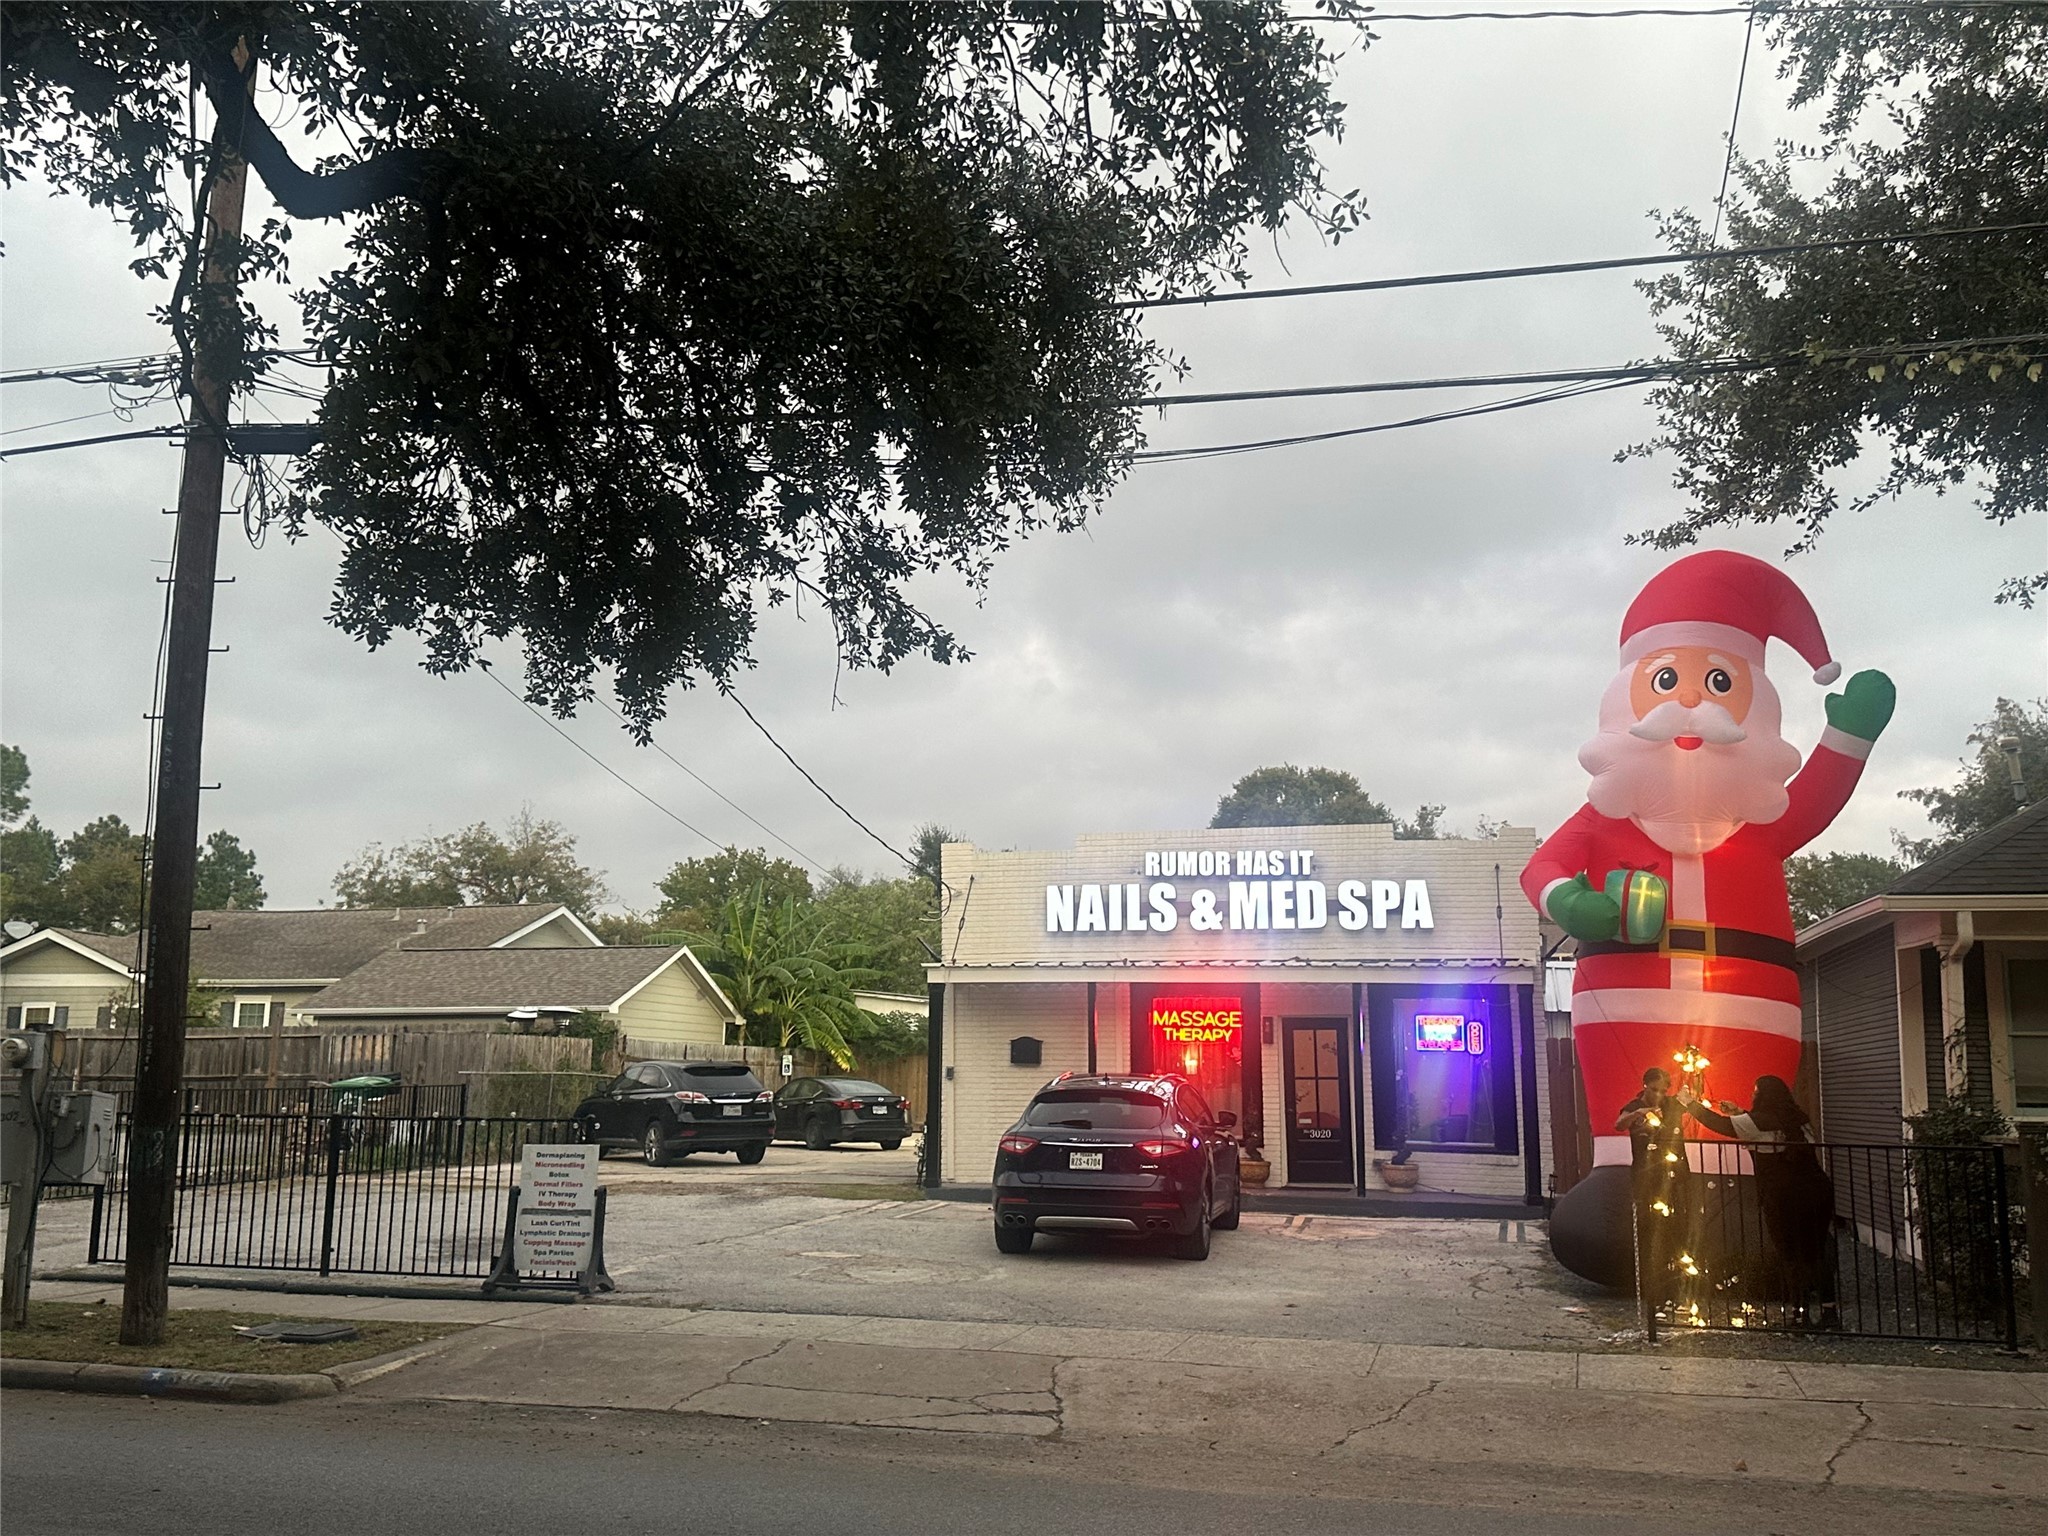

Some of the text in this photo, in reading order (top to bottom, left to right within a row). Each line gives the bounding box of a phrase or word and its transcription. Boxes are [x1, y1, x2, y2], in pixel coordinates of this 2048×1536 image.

[1145, 850, 1314, 876] RUMOR HAS IT
[1046, 879, 1435, 932] NAILS & MED SPA
[1153, 1010, 1243, 1027] MASSAGE
[1418, 1017, 1462, 1026] THREADING
[1163, 1027, 1233, 1042] THERAPY
[1470, 1024, 1480, 1052] OPEN
[1419, 1040, 1462, 1049] EYELASHES
[1310, 1129, 1332, 1138] 3020
[535, 1161, 585, 1169] Microneedling
[558, 1230, 591, 1238] Drainage
[523, 1239, 552, 1247] Cupping
